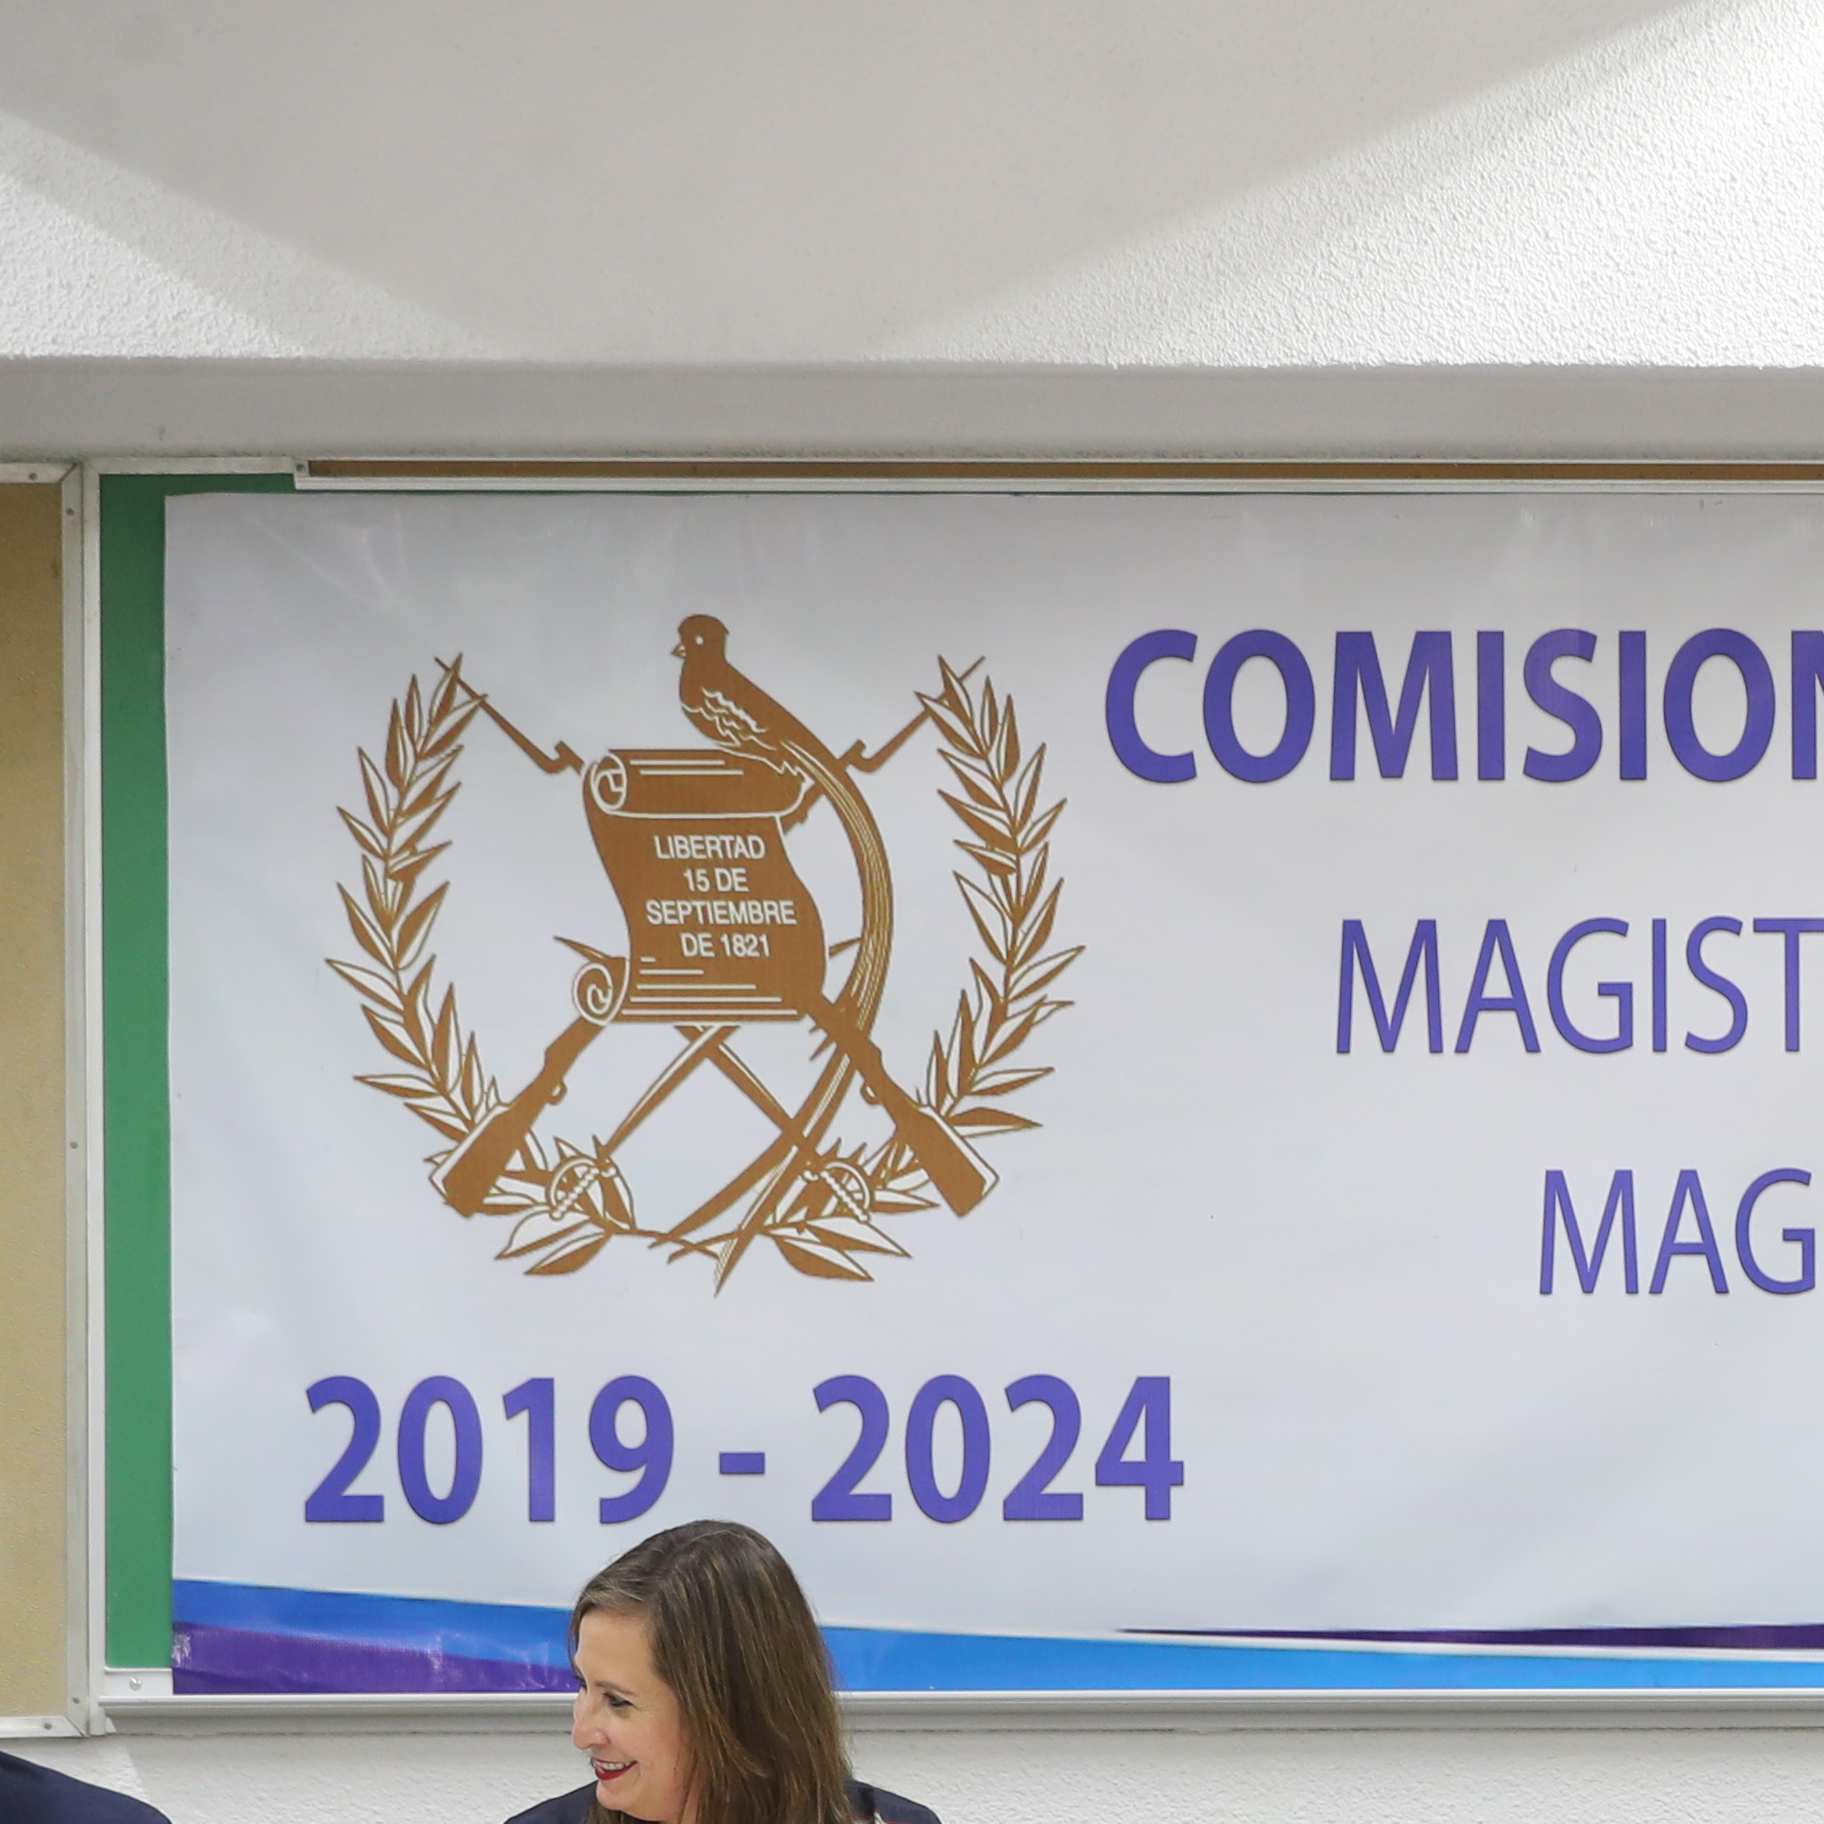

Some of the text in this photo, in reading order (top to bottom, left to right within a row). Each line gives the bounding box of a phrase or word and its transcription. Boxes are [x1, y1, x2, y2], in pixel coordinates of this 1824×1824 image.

[654, 834, 767, 860] LIBERTAD
[683, 866, 750, 893] 15 DE
[645, 899, 798, 926] SEPTIEMBRE
[680, 931, 770, 958] DE 1821
[303, 1373, 1185, 1526] 2019 - 2024
